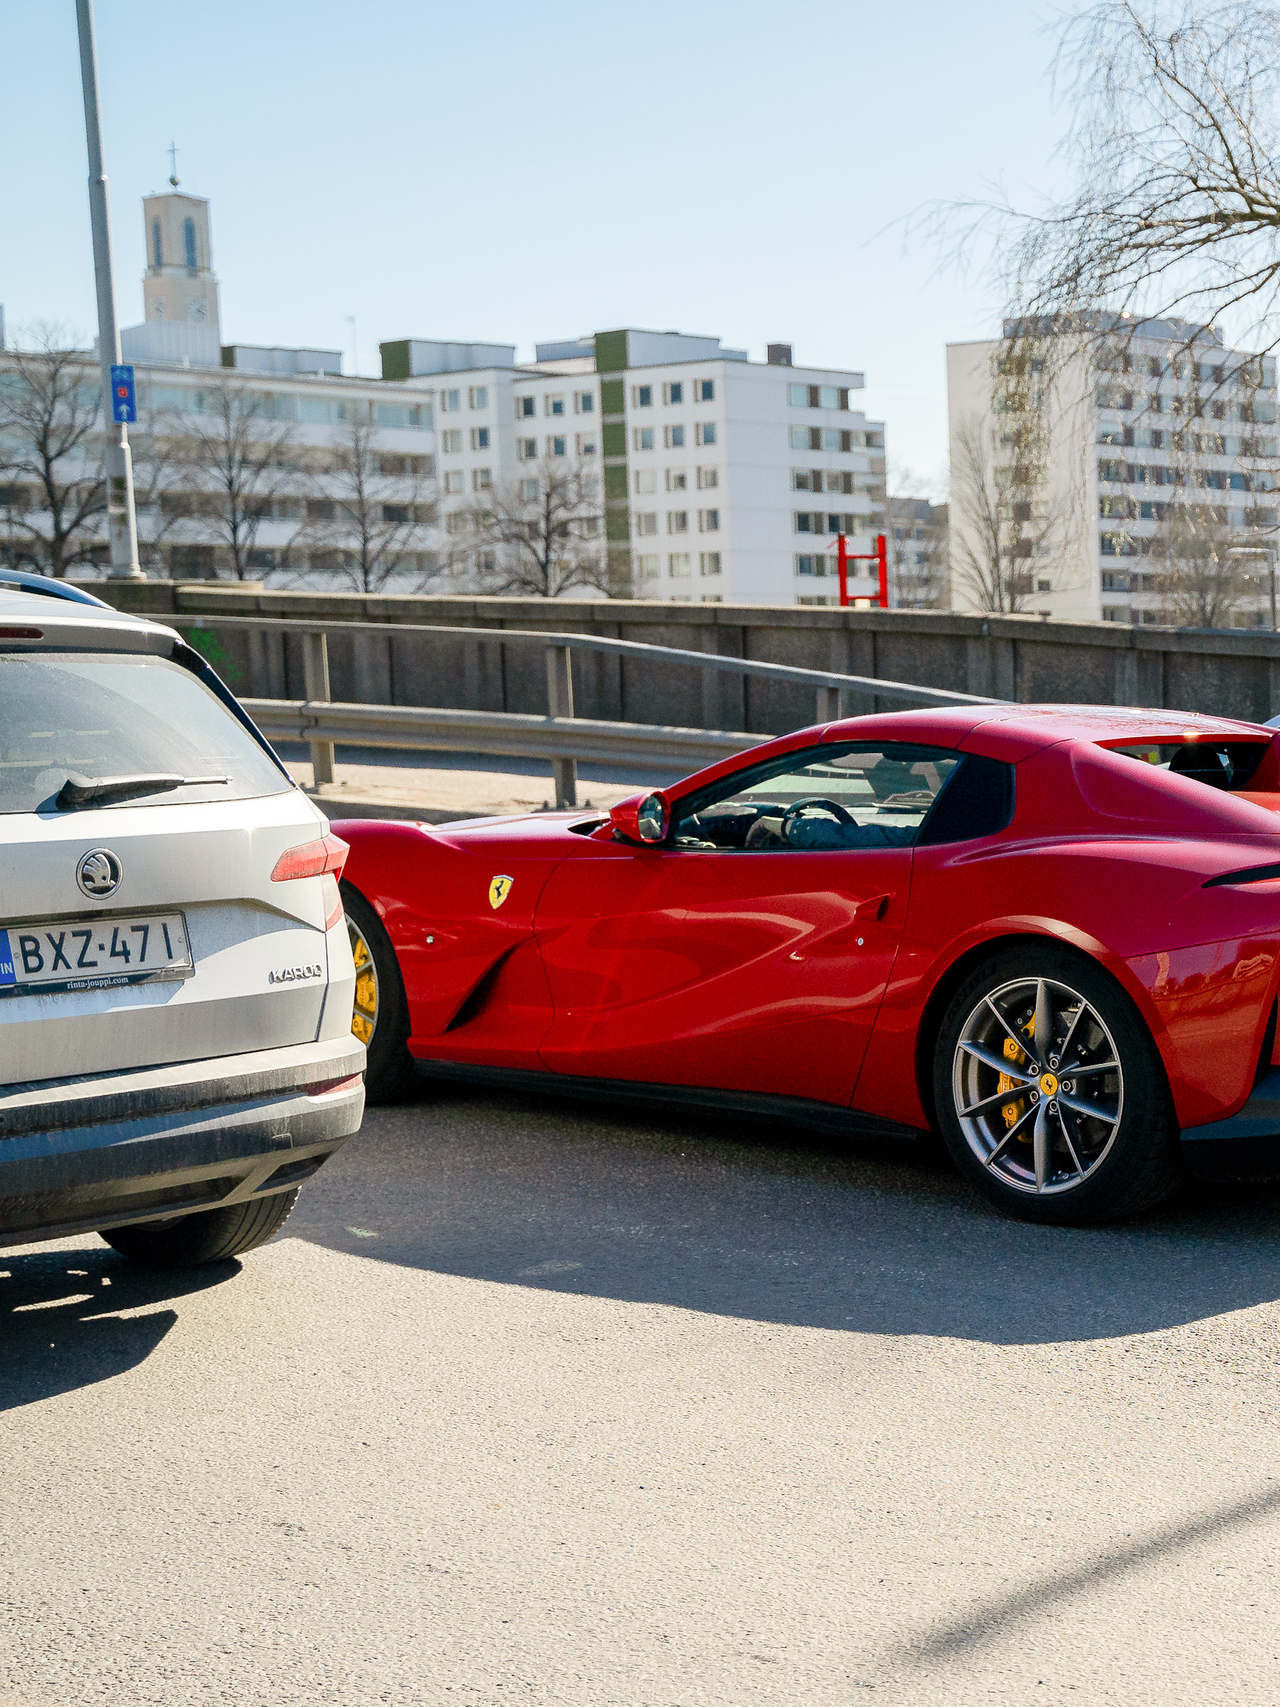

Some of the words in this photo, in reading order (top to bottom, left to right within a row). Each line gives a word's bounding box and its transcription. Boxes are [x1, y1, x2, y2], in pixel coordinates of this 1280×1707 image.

[18, 922, 174, 974] BXZ-471
[0, 962, 13, 974] IN
[67, 977, 129, 989] rinta-jouppi.com
